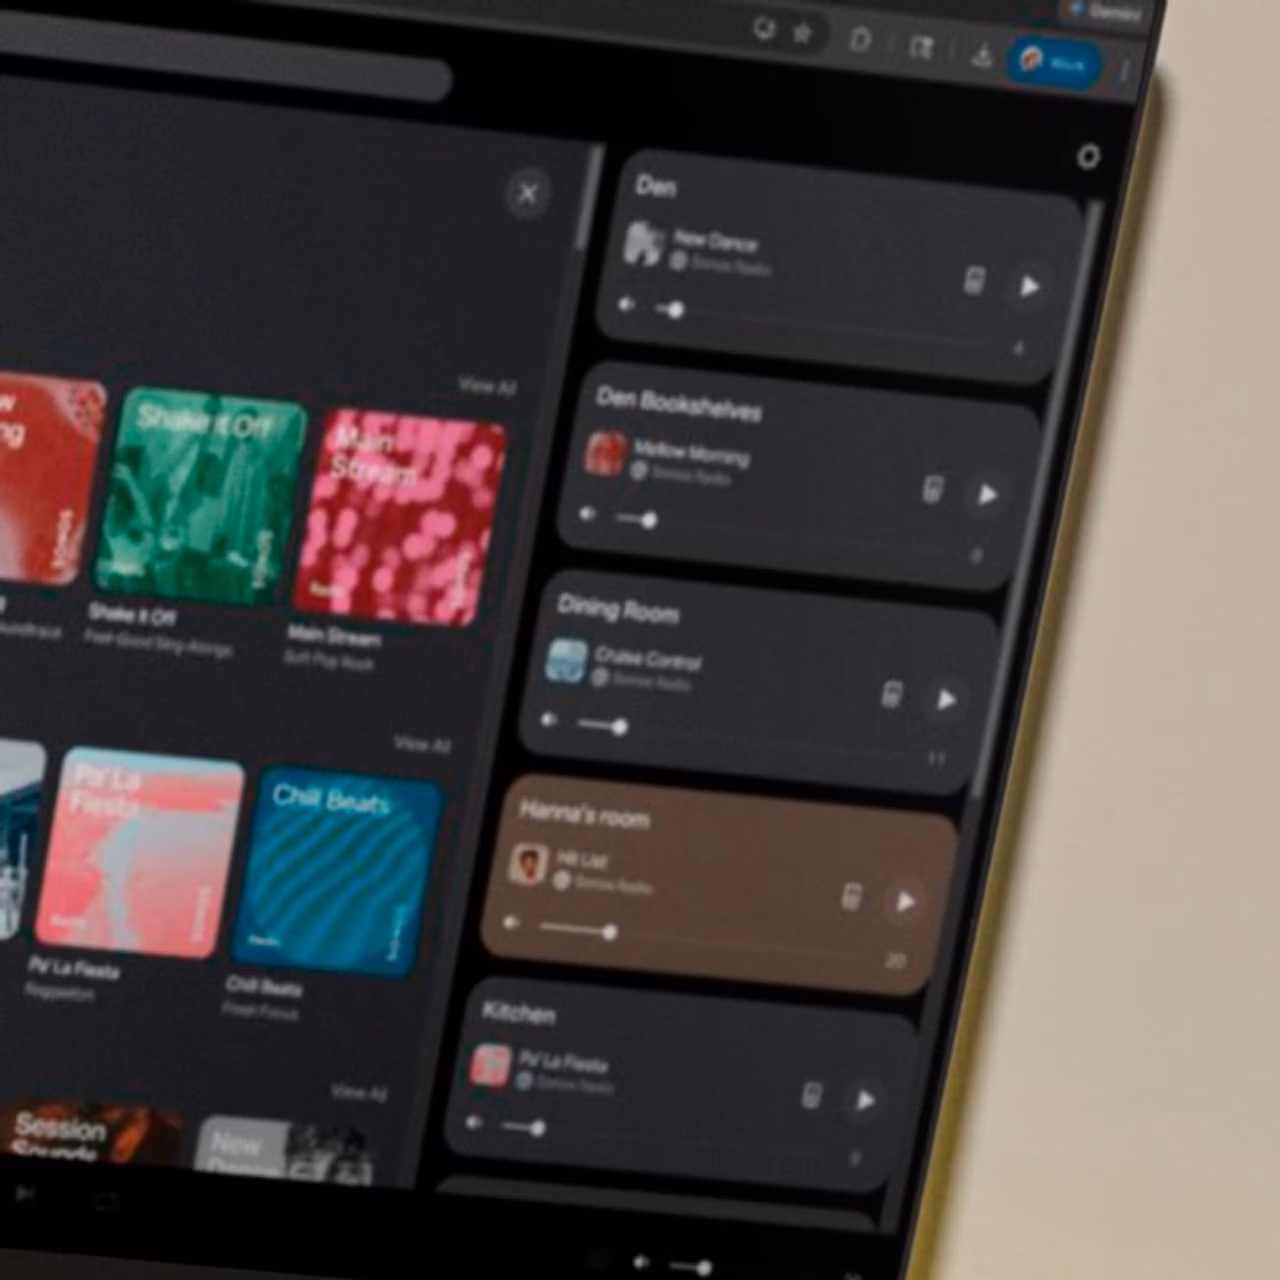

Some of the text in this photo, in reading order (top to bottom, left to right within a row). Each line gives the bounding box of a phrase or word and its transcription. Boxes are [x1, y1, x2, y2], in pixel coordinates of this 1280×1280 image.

[635, 172, 678, 199] Den
[557, 592, 681, 625] Dining Room
[273, 782, 391, 817] Chill Beats
[519, 797, 652, 830] Hanna's room
[481, 1000, 558, 1027] Kitchen
[15, 1111, 108, 1143] Session
